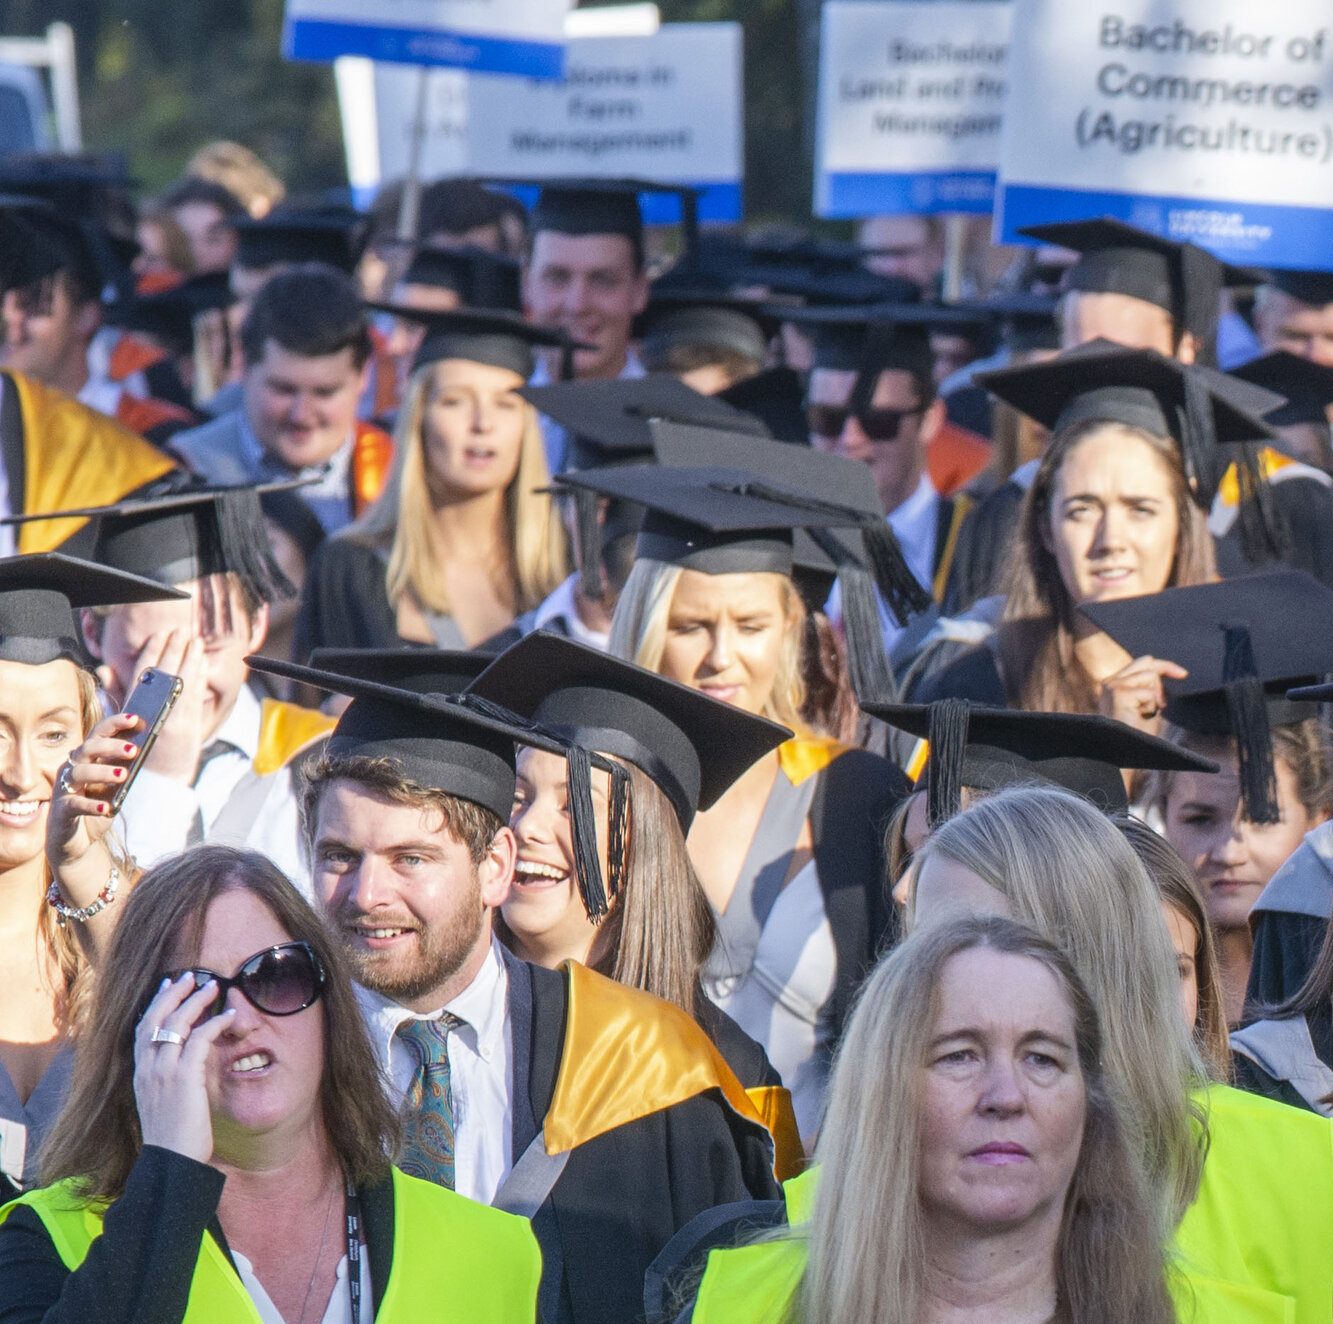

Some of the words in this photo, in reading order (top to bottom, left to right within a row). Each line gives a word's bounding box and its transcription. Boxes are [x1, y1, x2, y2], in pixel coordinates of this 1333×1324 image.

[1098, 14, 1274, 58] Bachelor
[1286, 26, 1327, 62] of
[1096, 62, 1322, 110] Commerce
